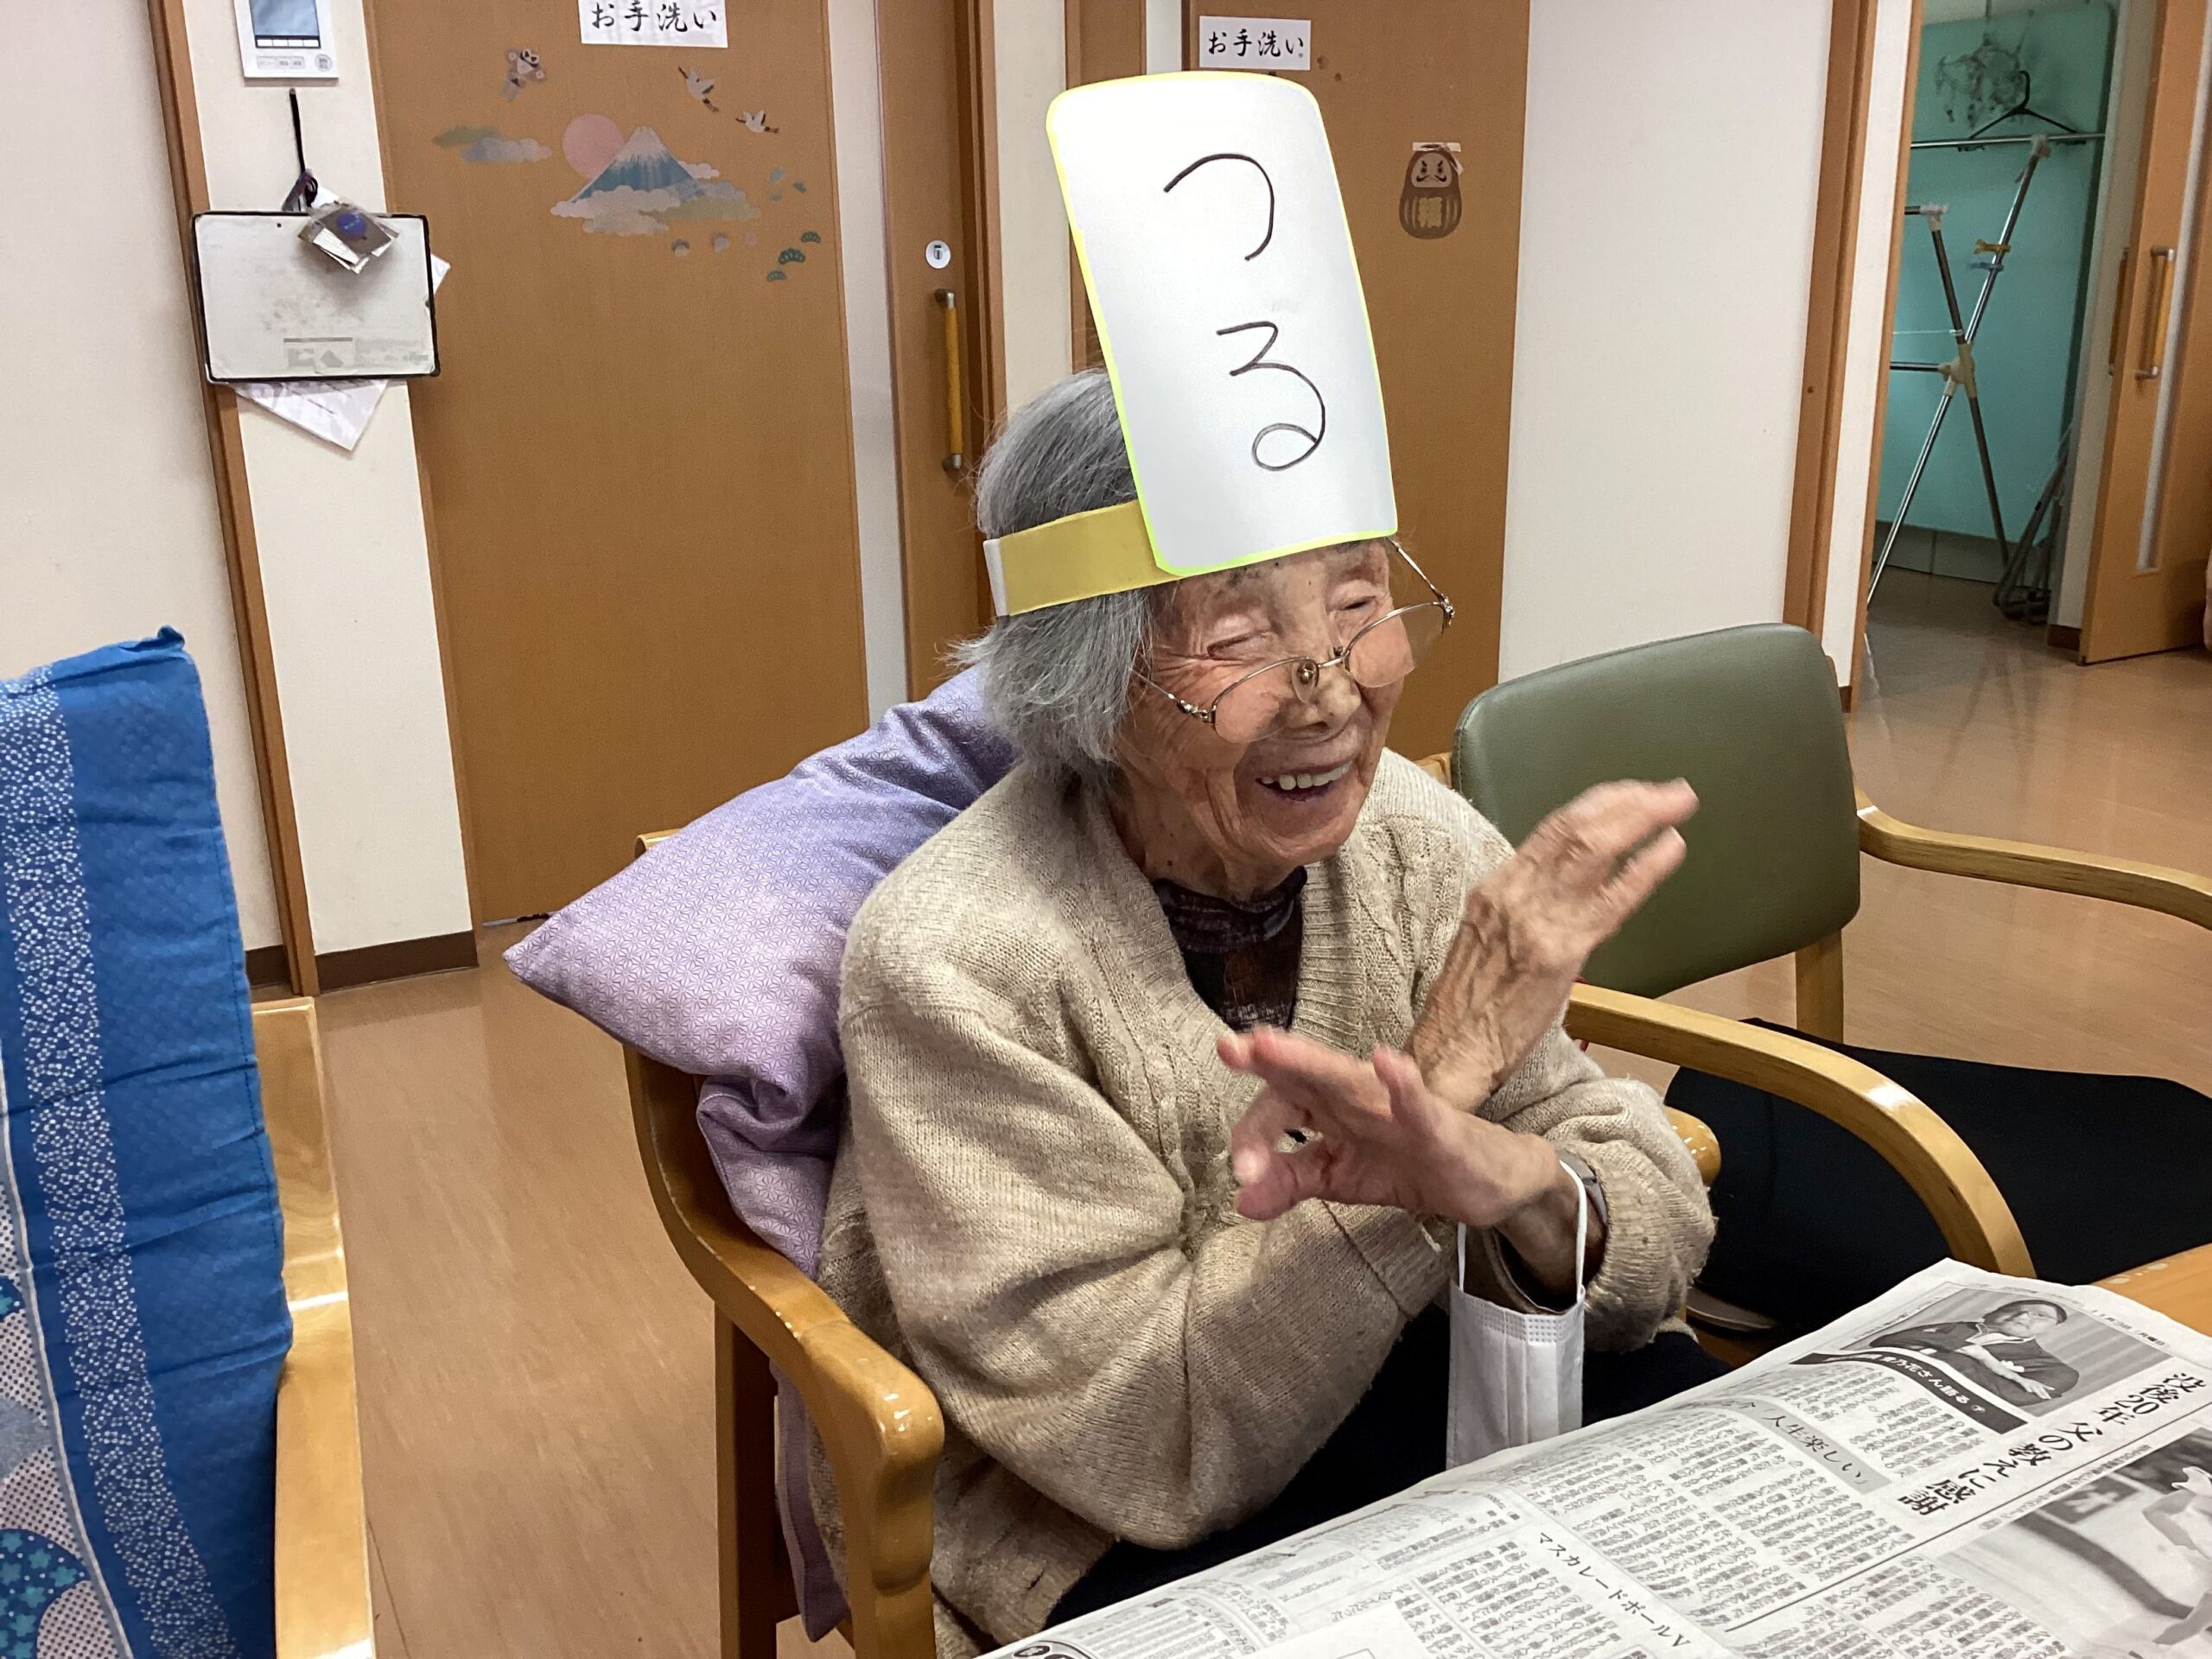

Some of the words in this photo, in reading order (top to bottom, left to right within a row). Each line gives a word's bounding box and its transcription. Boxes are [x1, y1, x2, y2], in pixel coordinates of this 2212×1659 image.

[591, 0, 717, 32] お手洗い
[1208, 28, 1305, 58] お手洗い
[1163, 152, 1325, 472] つる
[2093, 1371, 2207, 1426] 没後20年
[1897, 1421, 2104, 1516] 父の教えに感謝
